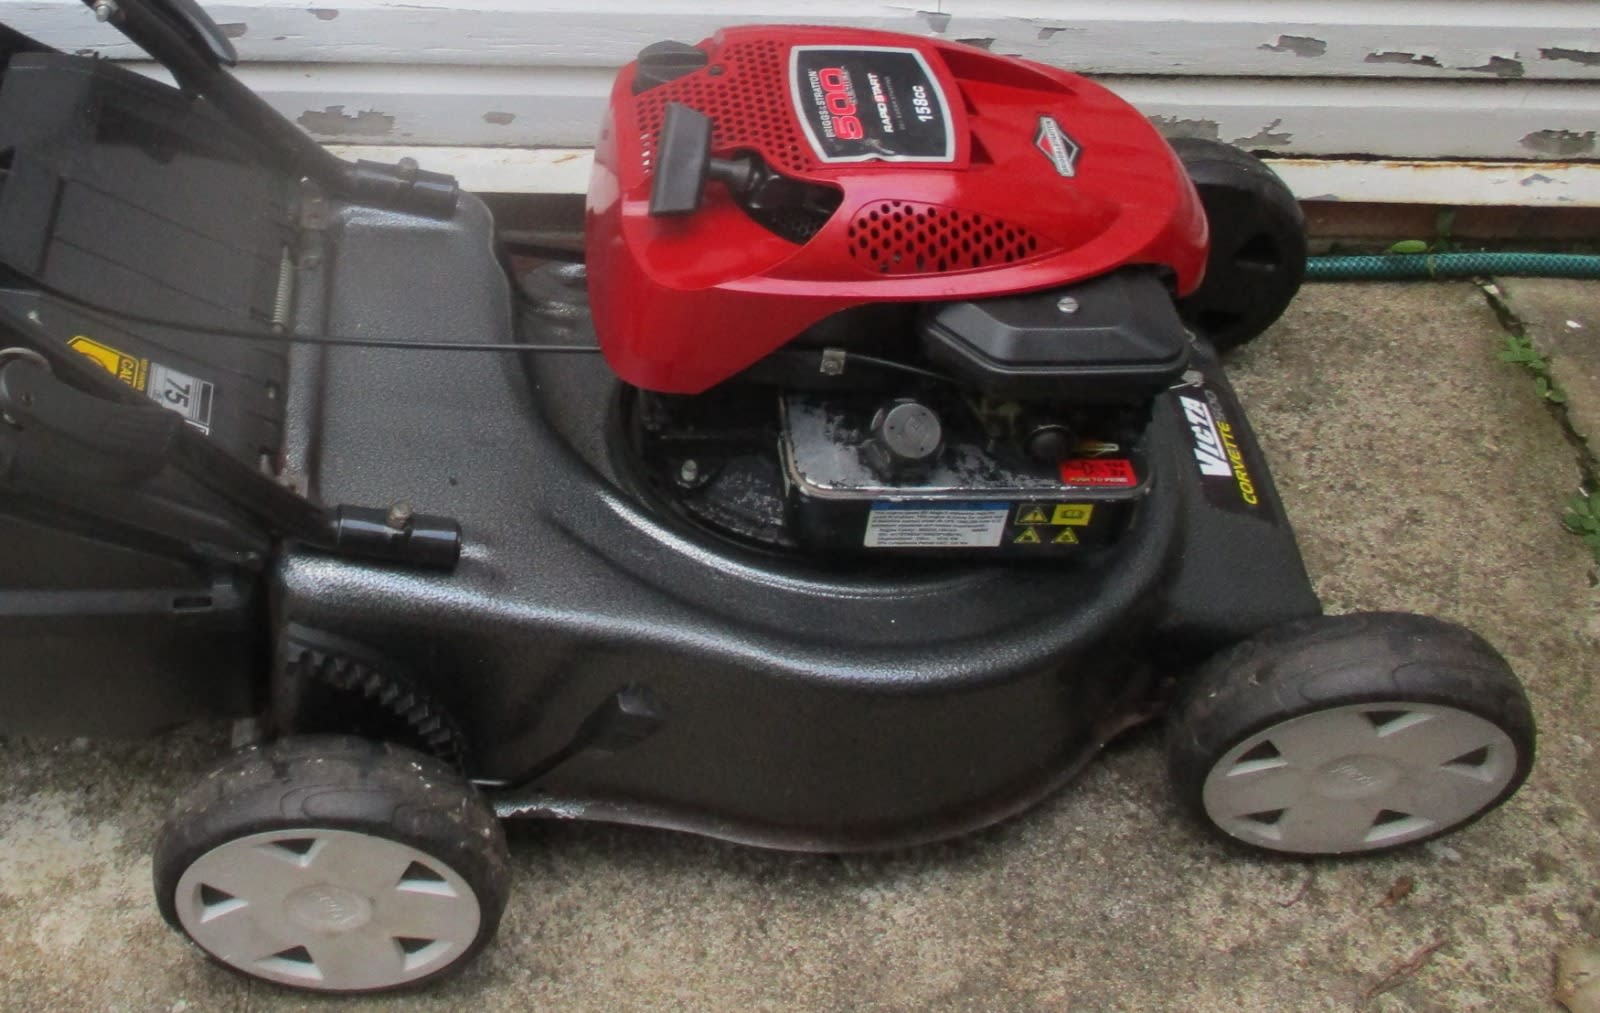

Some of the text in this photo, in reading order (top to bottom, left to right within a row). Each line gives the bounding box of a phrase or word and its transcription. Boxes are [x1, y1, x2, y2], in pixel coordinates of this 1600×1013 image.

[818, 67, 864, 140] 500
[912, 85, 935, 122] 158cc
[165, 378, 191, 408] 75
[1179, 396, 1232, 477] VICTA
[1216, 420, 1258, 505] CORVETTE
